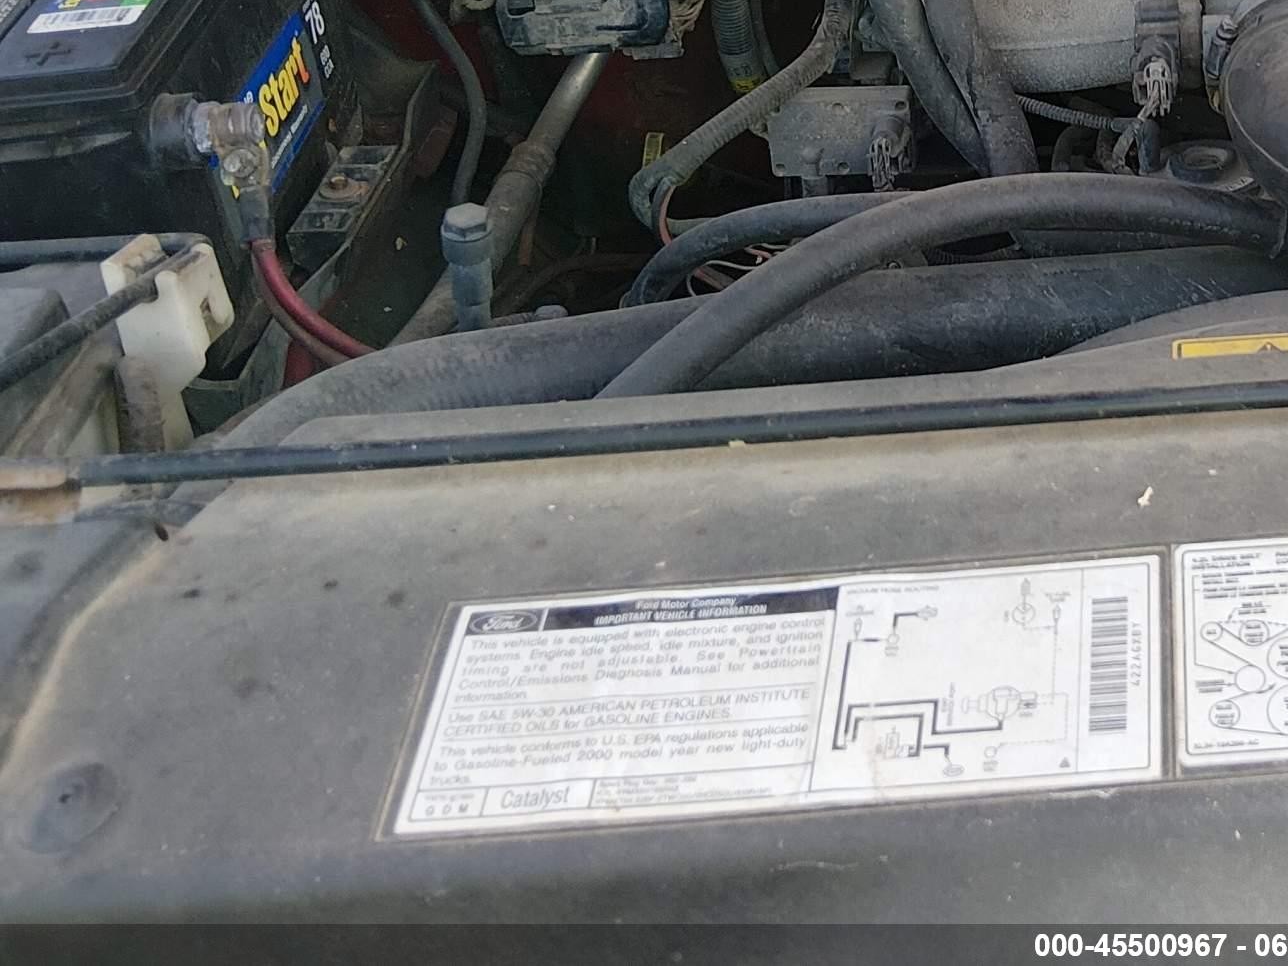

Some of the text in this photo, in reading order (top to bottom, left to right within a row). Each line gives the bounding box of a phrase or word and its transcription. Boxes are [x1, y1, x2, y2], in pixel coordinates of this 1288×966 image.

[305, 1, 326, 44] 78
[594, 604, 768, 626] IMPORTANT VEHICLE INFORMATION
[636, 597, 736, 610] Ford Motor Company
[472, 616, 826, 650] This vehicle is equipped with electronic engine control
[482, 616, 523, 630] Ford
[523, 661, 547, 673] are
[561, 660, 585, 672] not
[696, 650, 725, 663] See
[738, 644, 822, 658] Powertrain
[530, 648, 577, 661] Engine
[581, 644, 605, 656] idle
[659, 639, 684, 651] idle
[747, 633, 771, 644] and
[775, 632, 824, 646] ignition
[458, 655, 820, 691] Control/Emissions Diagnosis Manual for additional
[478, 709, 505, 722] SAE
[511, 706, 554, 720] 5W-30
[558, 698, 637, 717] AMERICAN
[640, 693, 731, 710] PETROLEUM
[735, 687, 811, 704] INSTITUTE
[443, 721, 522, 738] CERTIFIED
[564, 718, 581, 730] for
[584, 710, 660, 728] GASOLINE
[439, 744, 466, 757] This
[585, 735, 597, 747] to
[602, 733, 631, 747] U.S.
[634, 732, 662, 745] EPA
[666, 728, 738, 744] regulations
[742, 722, 809, 738] applicable
[454, 752, 571, 771] Gasoline-Fueled
[577, 749, 613, 762] 2000
[619, 746, 663, 760] model
[669, 744, 702, 759] year
[706, 742, 735, 754] new
[741, 736, 807, 753] light-duty
[500, 786, 571, 811] Catalyst
